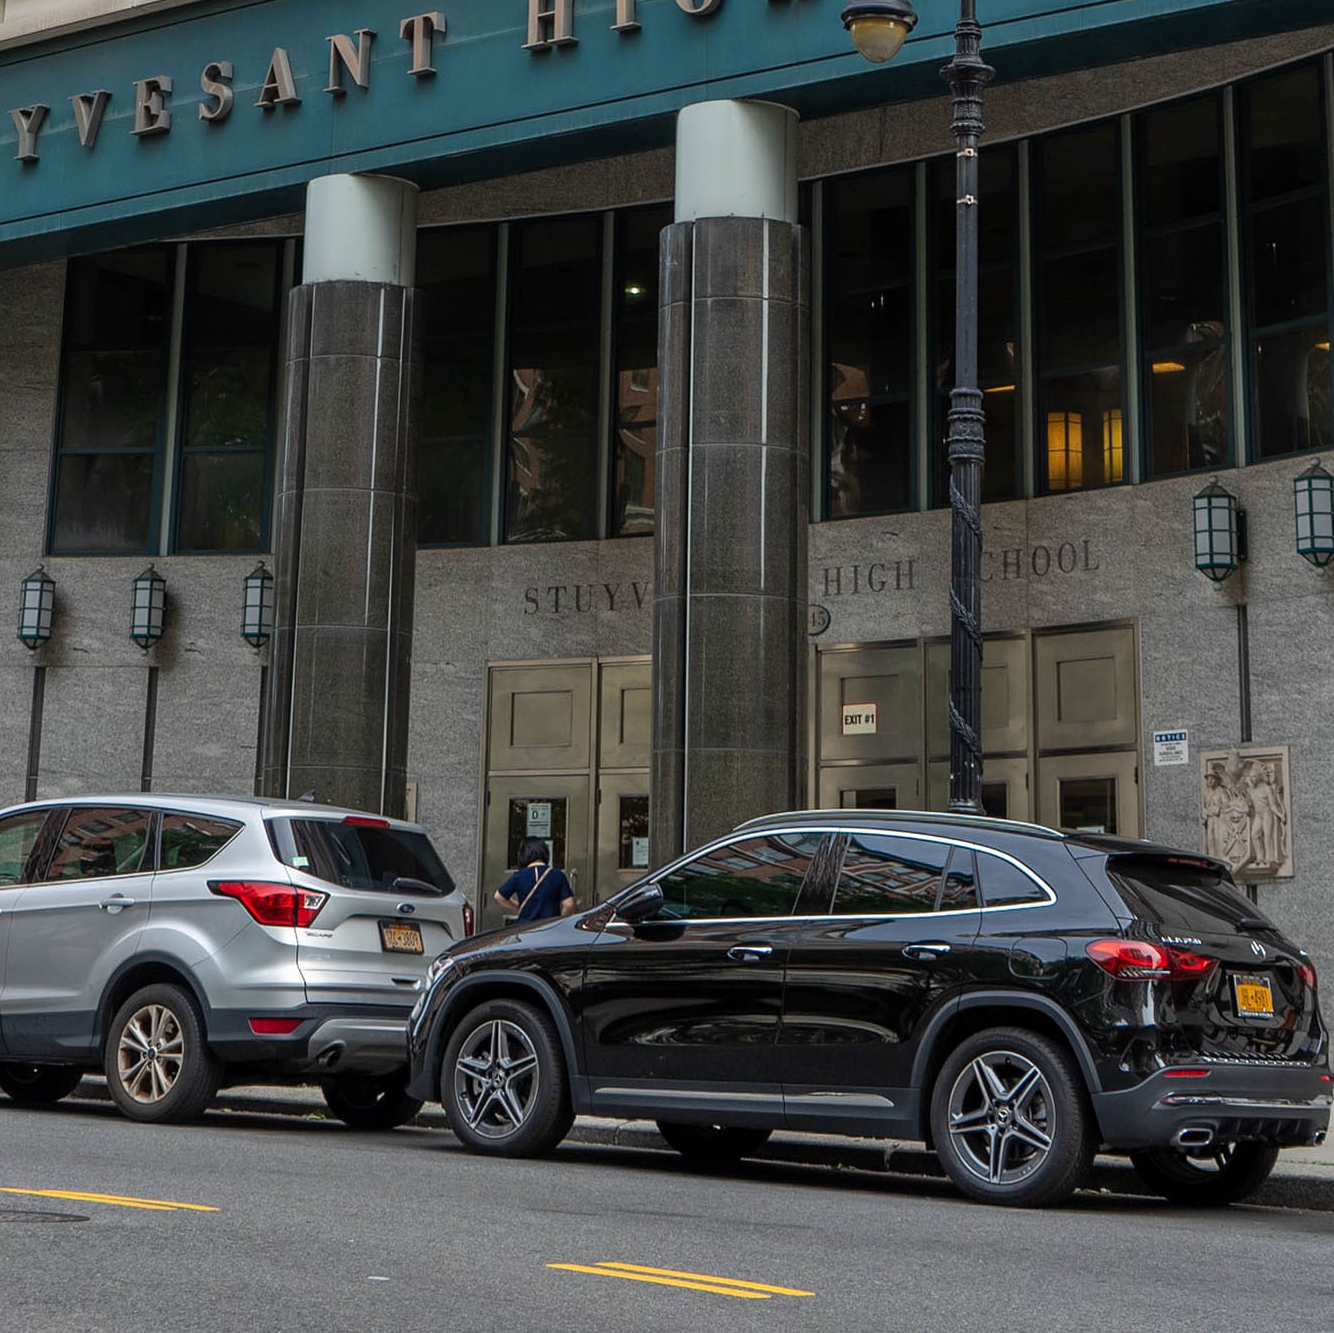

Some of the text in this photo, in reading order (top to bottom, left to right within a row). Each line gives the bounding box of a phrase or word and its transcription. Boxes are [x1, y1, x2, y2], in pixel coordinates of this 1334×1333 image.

[523, 539, 1100, 616] STUYV HIGH CHOOL
[844, 714, 875, 725] EXIT #1
